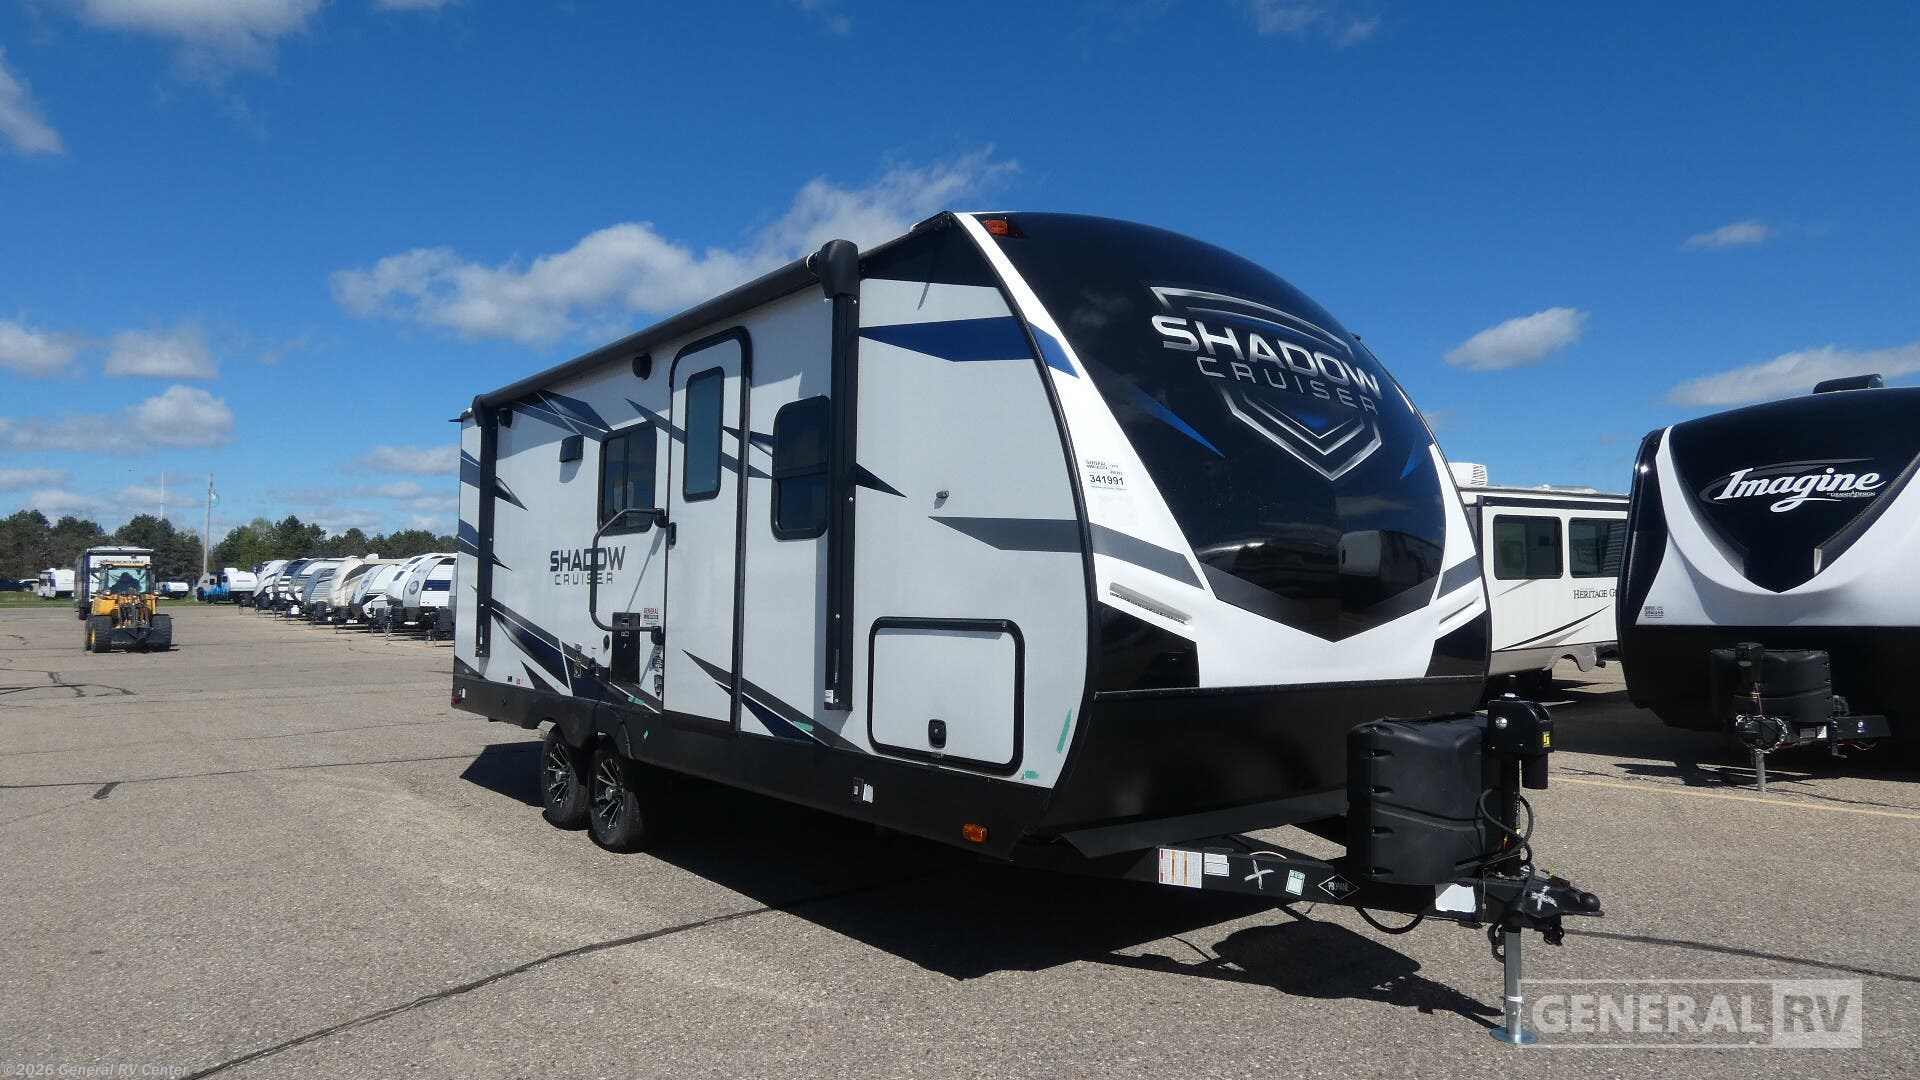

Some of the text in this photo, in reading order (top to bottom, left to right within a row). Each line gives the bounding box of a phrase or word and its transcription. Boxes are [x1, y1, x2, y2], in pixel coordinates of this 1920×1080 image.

[1151, 314, 1382, 400] SHADOW
[1196, 356, 1379, 415] CRUISER
[1089, 474, 1124, 486] 341991
[1713, 467, 1887, 513] Imagine
[550, 546, 626, 572] SHADOW
[1573, 589, 1608, 599] HERITAGE
